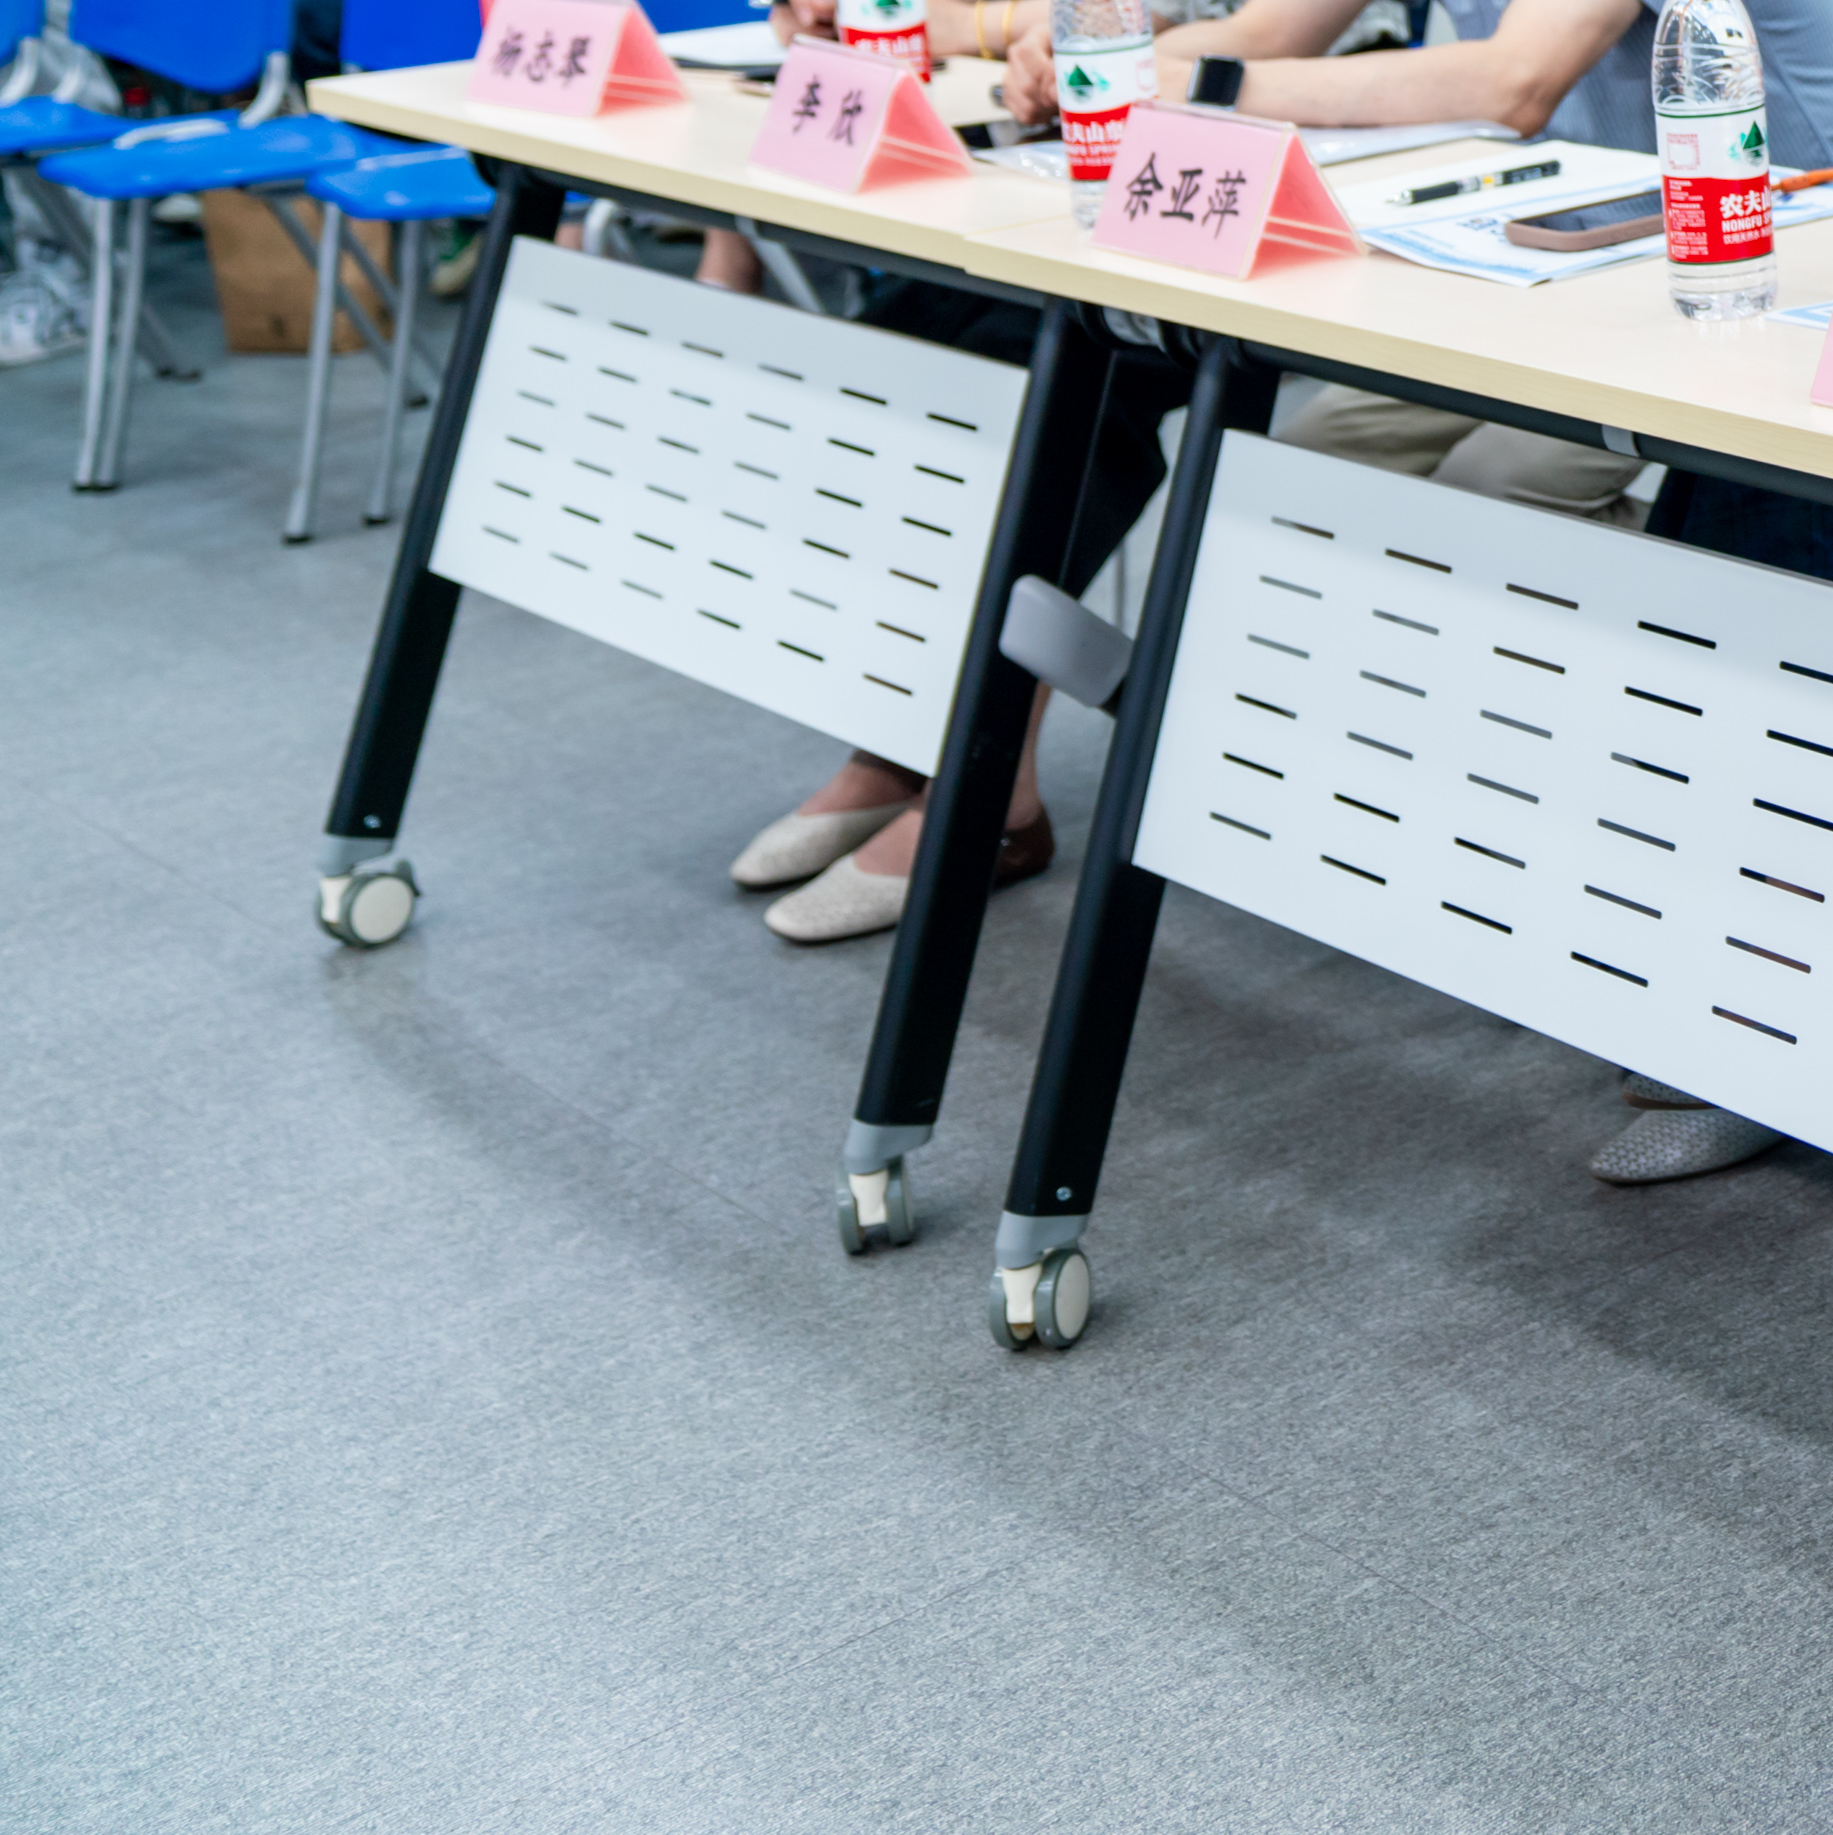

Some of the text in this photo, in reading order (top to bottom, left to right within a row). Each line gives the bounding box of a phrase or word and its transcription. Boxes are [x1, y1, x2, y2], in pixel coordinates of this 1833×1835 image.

[1124, 152, 1247, 240] 余亚萍
[1721, 214, 1762, 233] NONGFU
